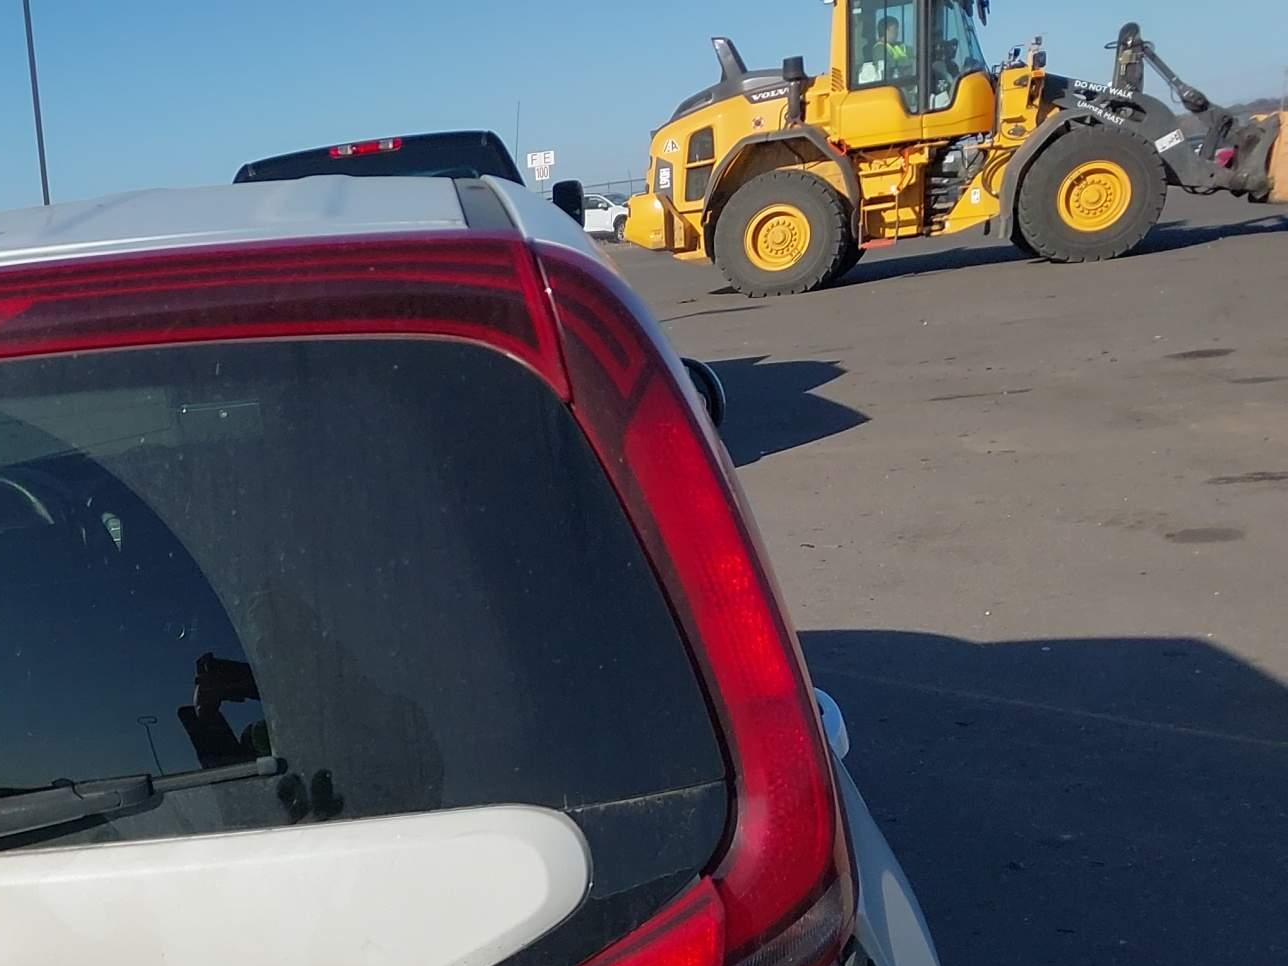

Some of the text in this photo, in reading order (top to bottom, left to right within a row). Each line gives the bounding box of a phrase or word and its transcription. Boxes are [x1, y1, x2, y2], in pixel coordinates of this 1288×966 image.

[751, 87, 789, 101] VOLV
[1074, 80, 1133, 98] DO NOT WALK
[1103, 113, 1124, 125] MAST
[536, 166, 549, 178] 100
